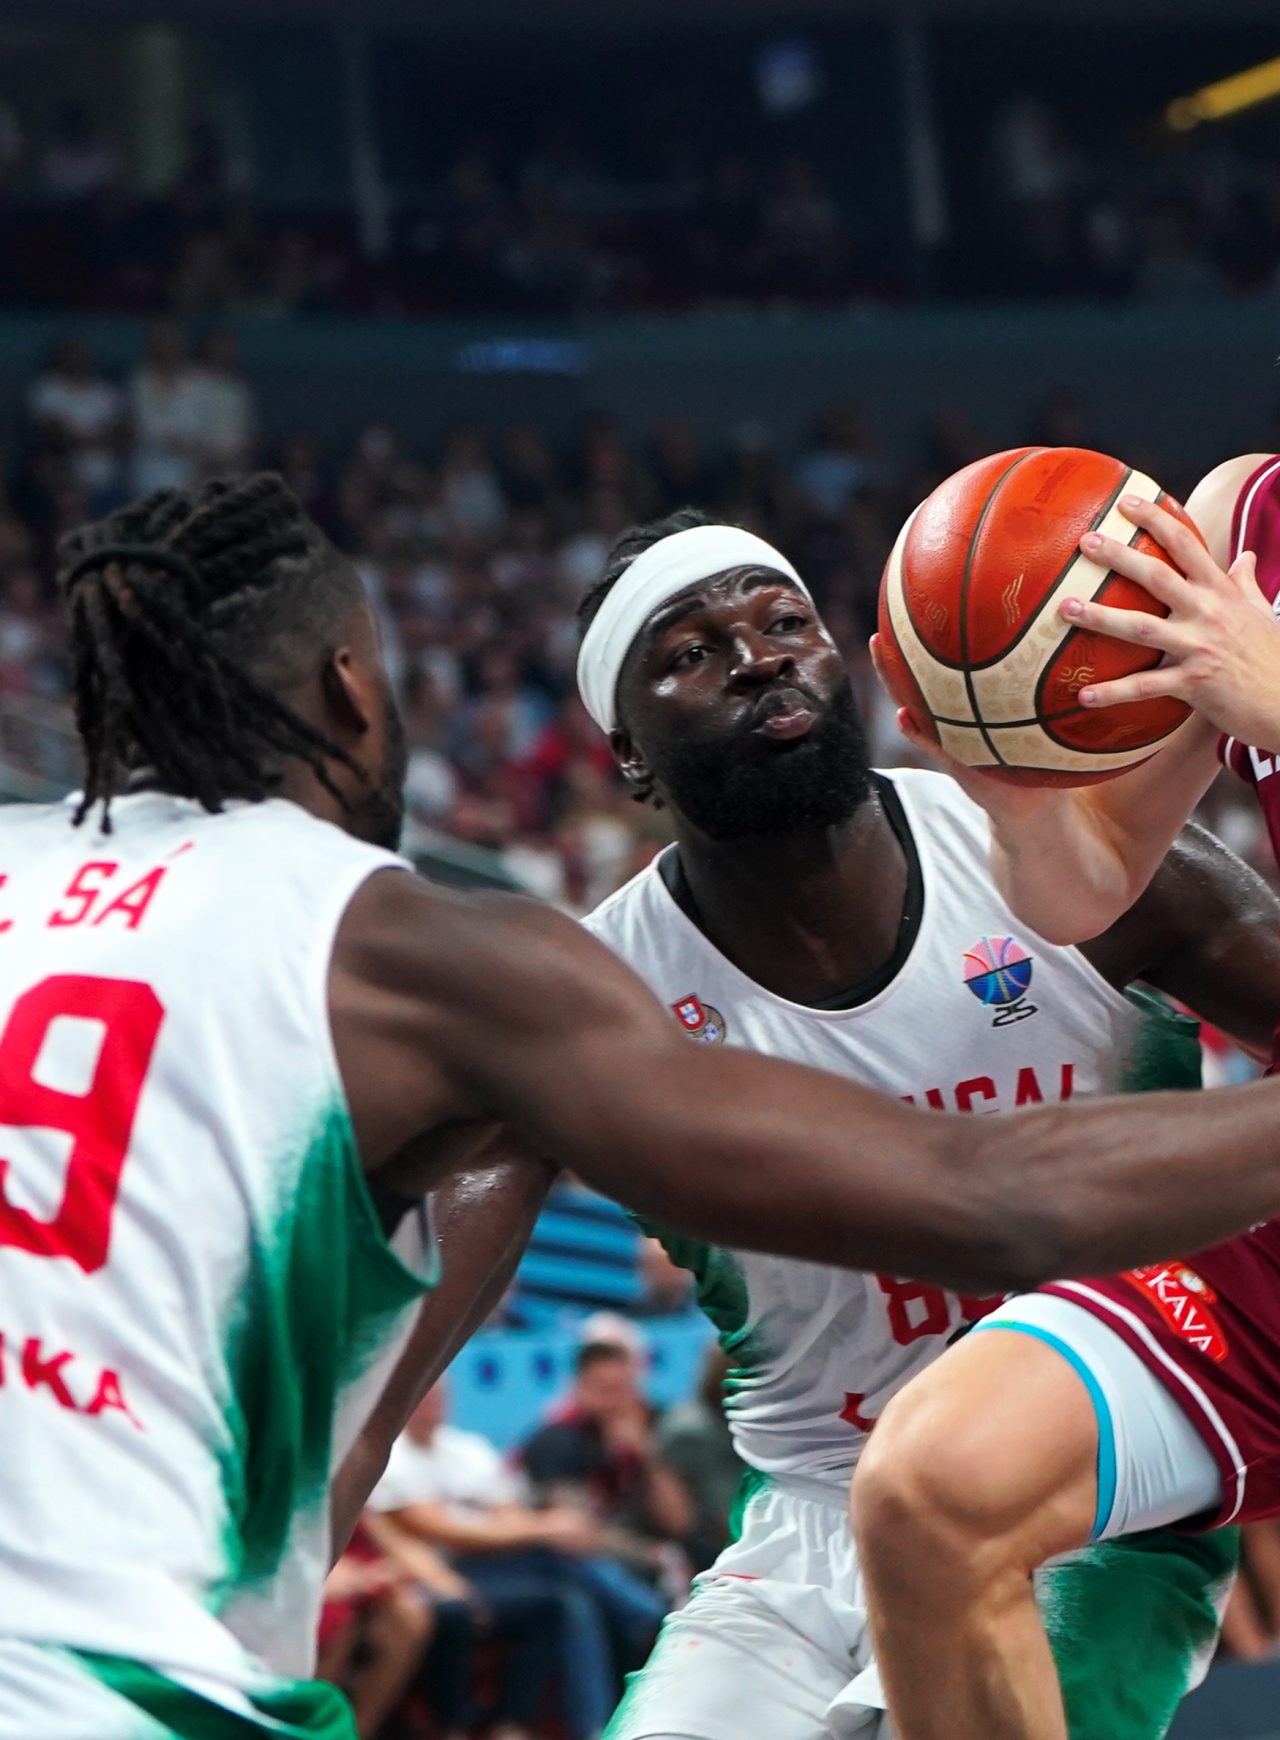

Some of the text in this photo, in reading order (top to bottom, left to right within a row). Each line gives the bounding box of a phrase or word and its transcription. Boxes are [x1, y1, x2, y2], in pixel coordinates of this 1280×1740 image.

[46, 841, 194, 931] SÁ
[0, 974, 166, 1276] 9
[0, 1330, 146, 1431] KA
